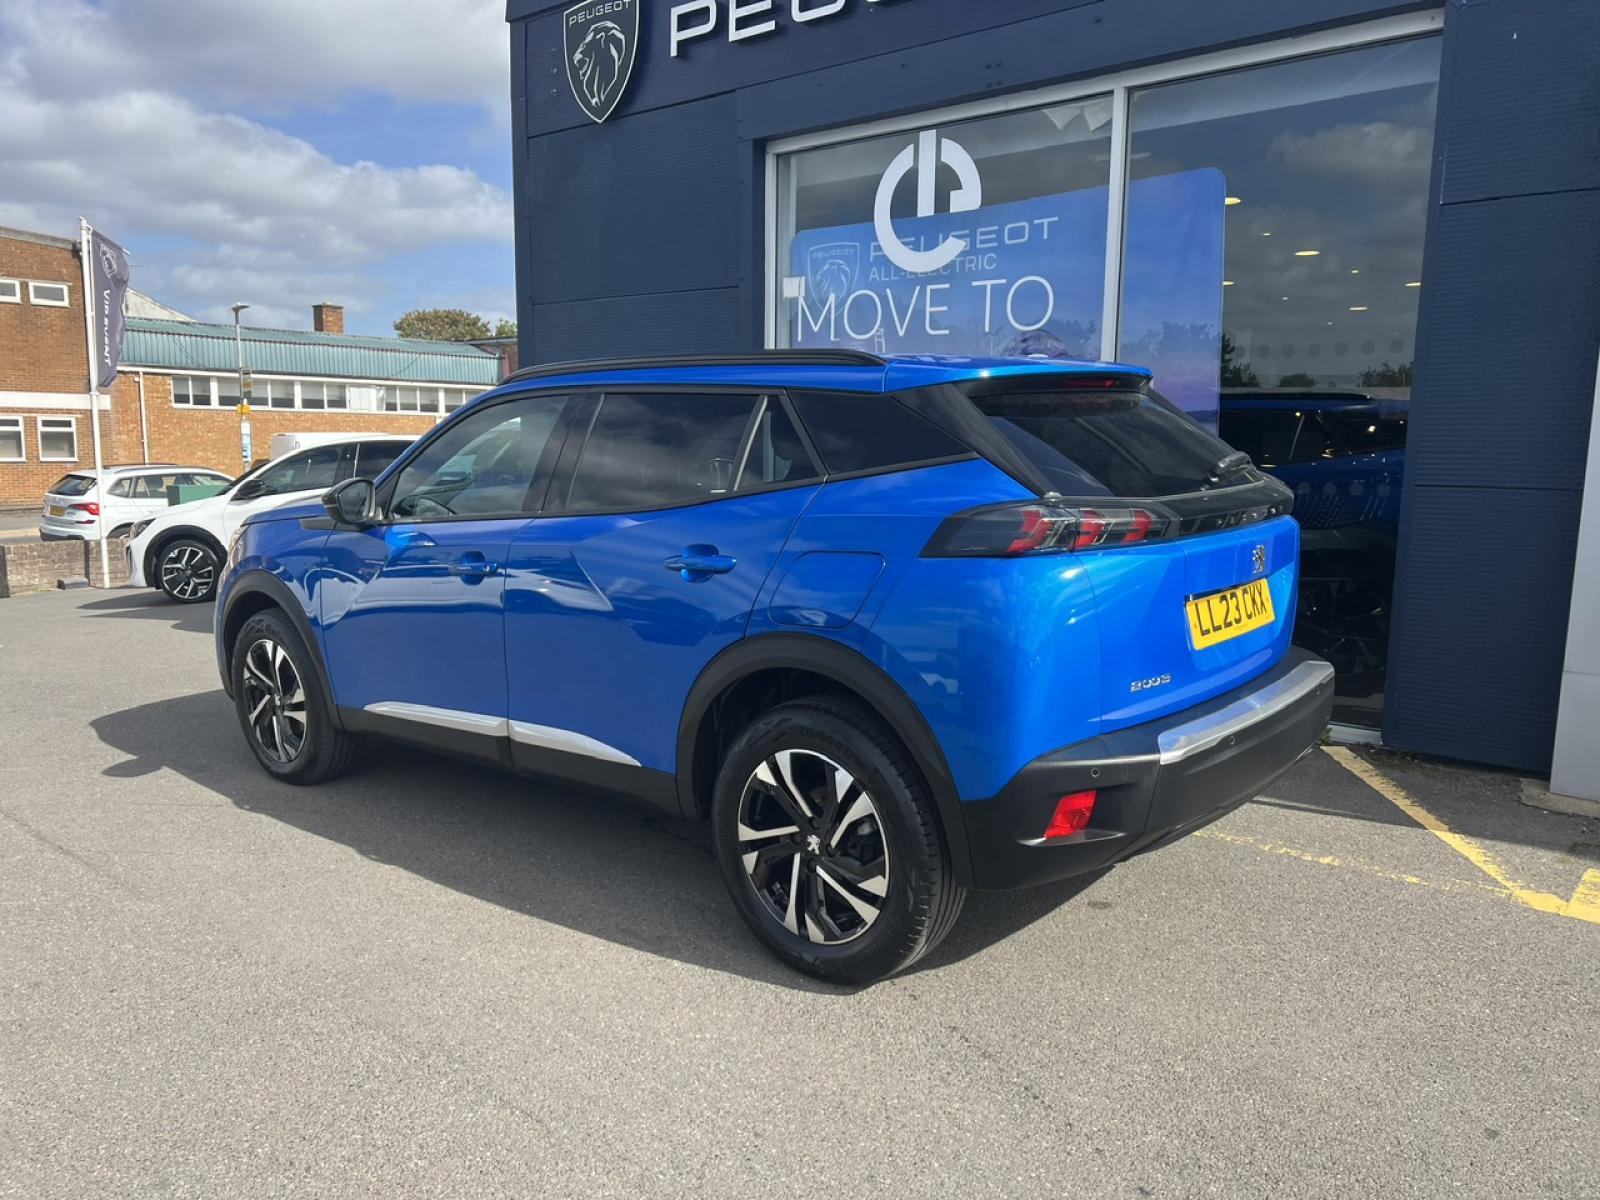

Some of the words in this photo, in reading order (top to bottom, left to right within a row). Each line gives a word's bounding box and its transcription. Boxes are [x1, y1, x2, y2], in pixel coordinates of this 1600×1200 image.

[569, 0, 631, 27] PEUGEOT
[103, 289, 111, 315] VIP
[797, 283, 950, 342] MOVE
[971, 275, 1055, 332] TO
[103, 315, 112, 367] EVENT
[1195, 591, 1242, 637] LL23
[1242, 582, 1267, 621] CKX
[1130, 673, 1171, 692] 2008
